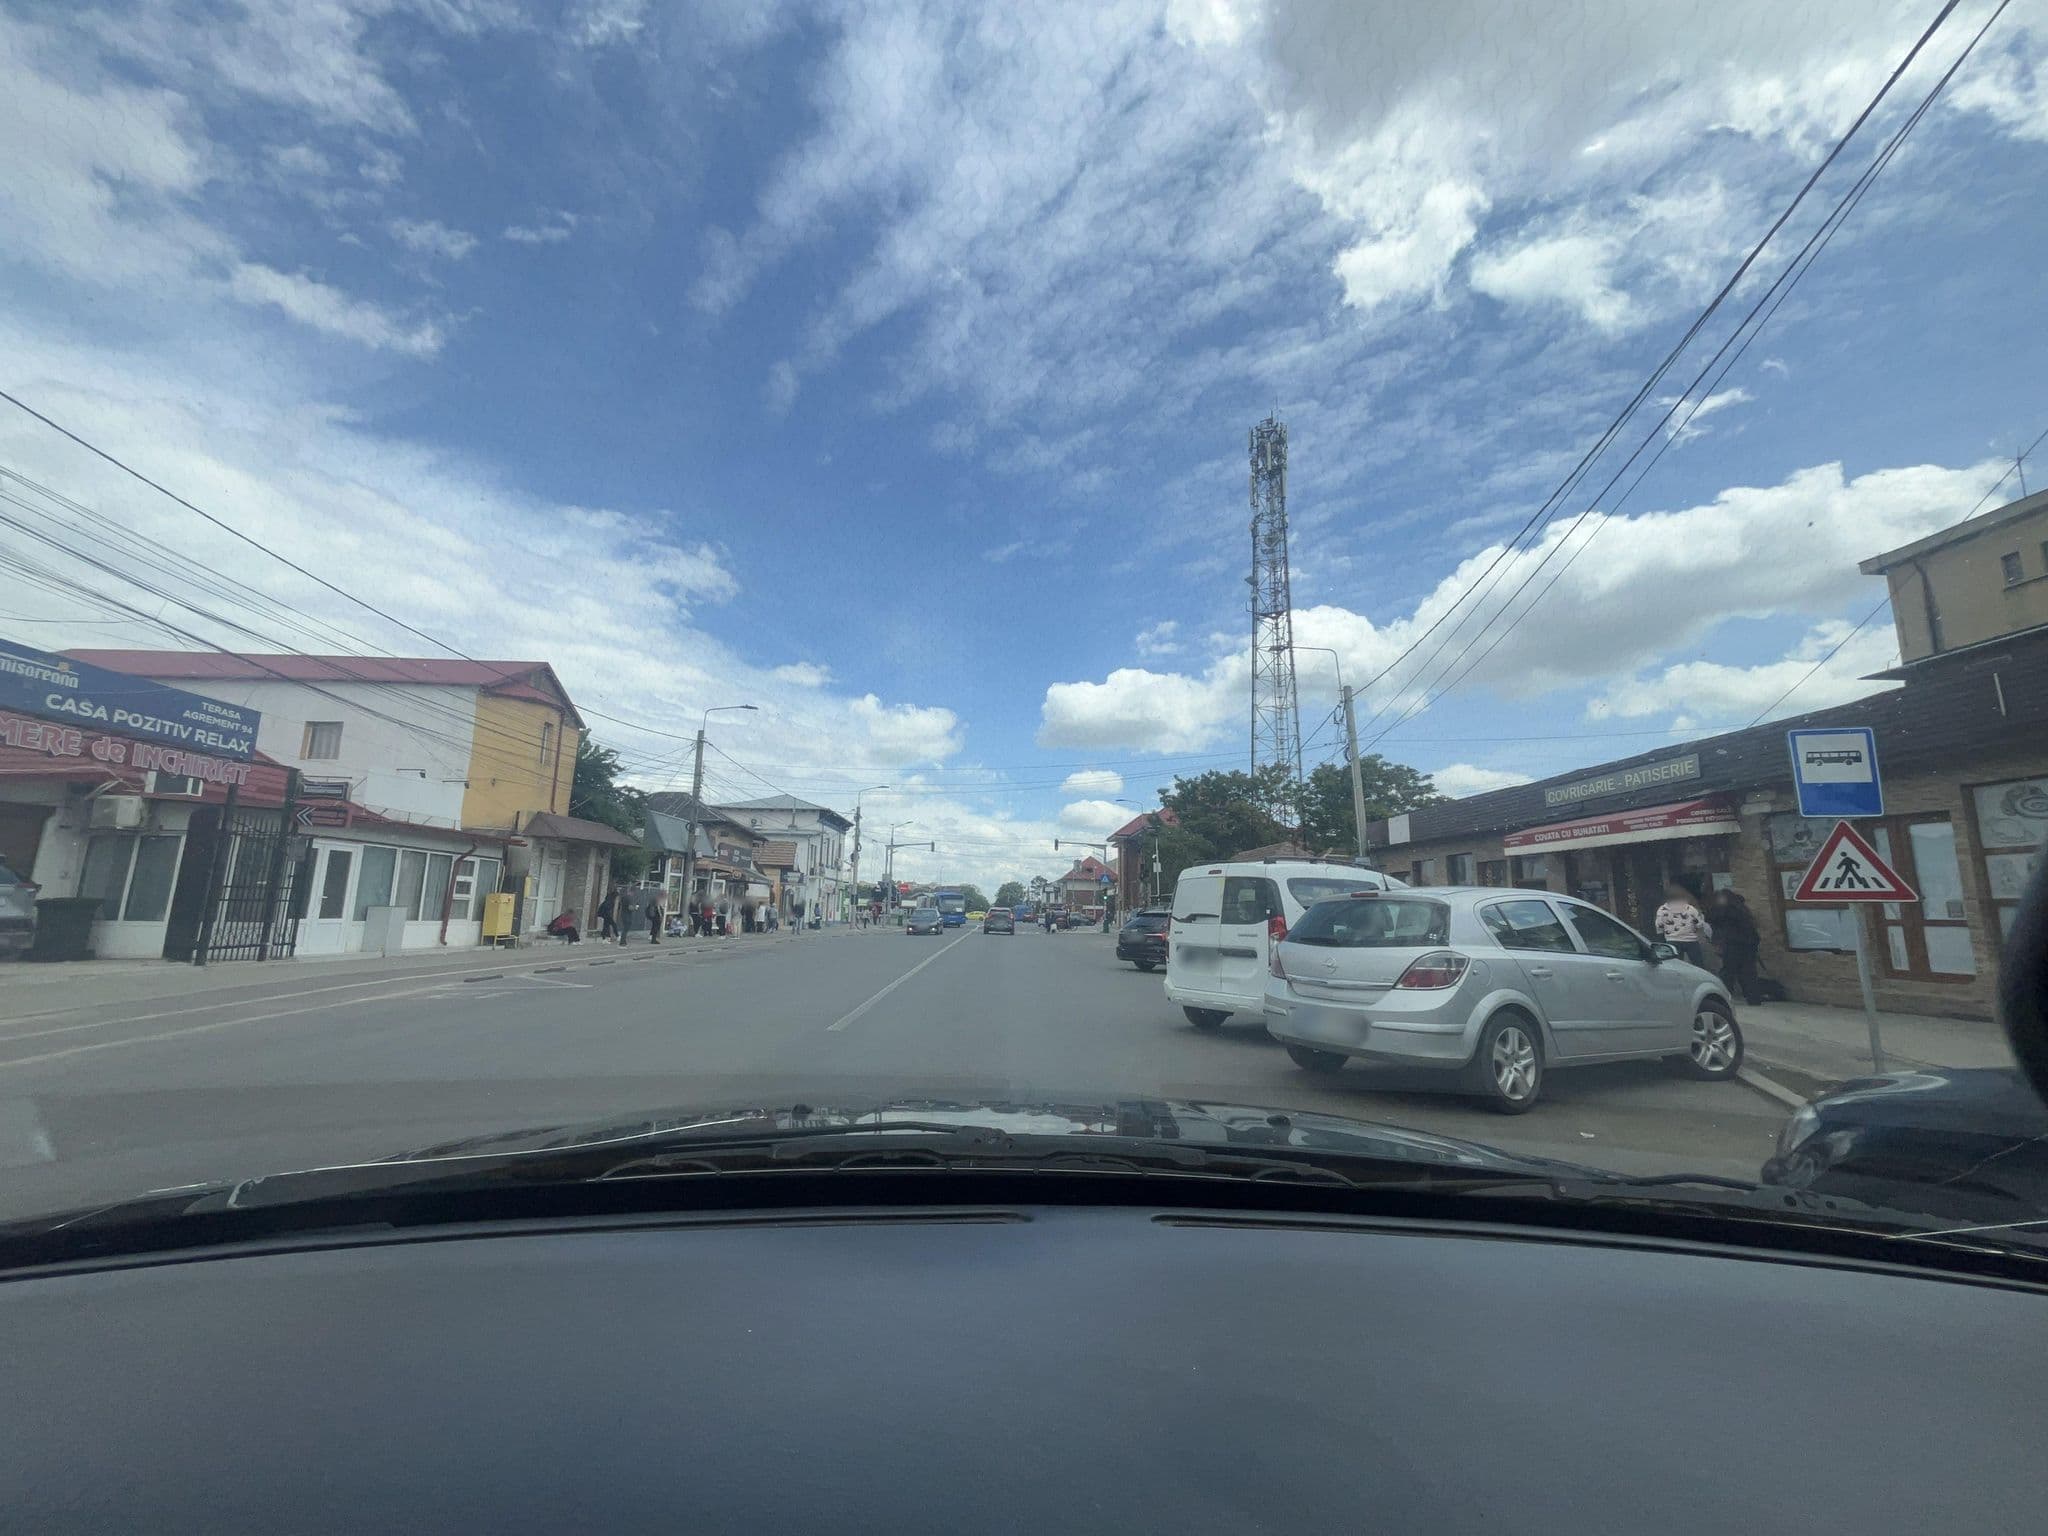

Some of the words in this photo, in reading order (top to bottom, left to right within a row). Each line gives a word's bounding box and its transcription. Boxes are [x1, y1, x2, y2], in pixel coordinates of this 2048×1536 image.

[46, 693, 109, 721] CASA
[113, 709, 192, 739] POZITIV
[194, 728, 250, 754] RELAX
[182, 709, 241, 731] AGREMENT
[202, 702, 241, 720] TERASA
[91, 736, 126, 763] de
[131, 742, 251, 785] INCHIRIAT
[1547, 777, 1617, 804] COVRIGARIE
[1624, 759, 1696, 787] PATISERIE
